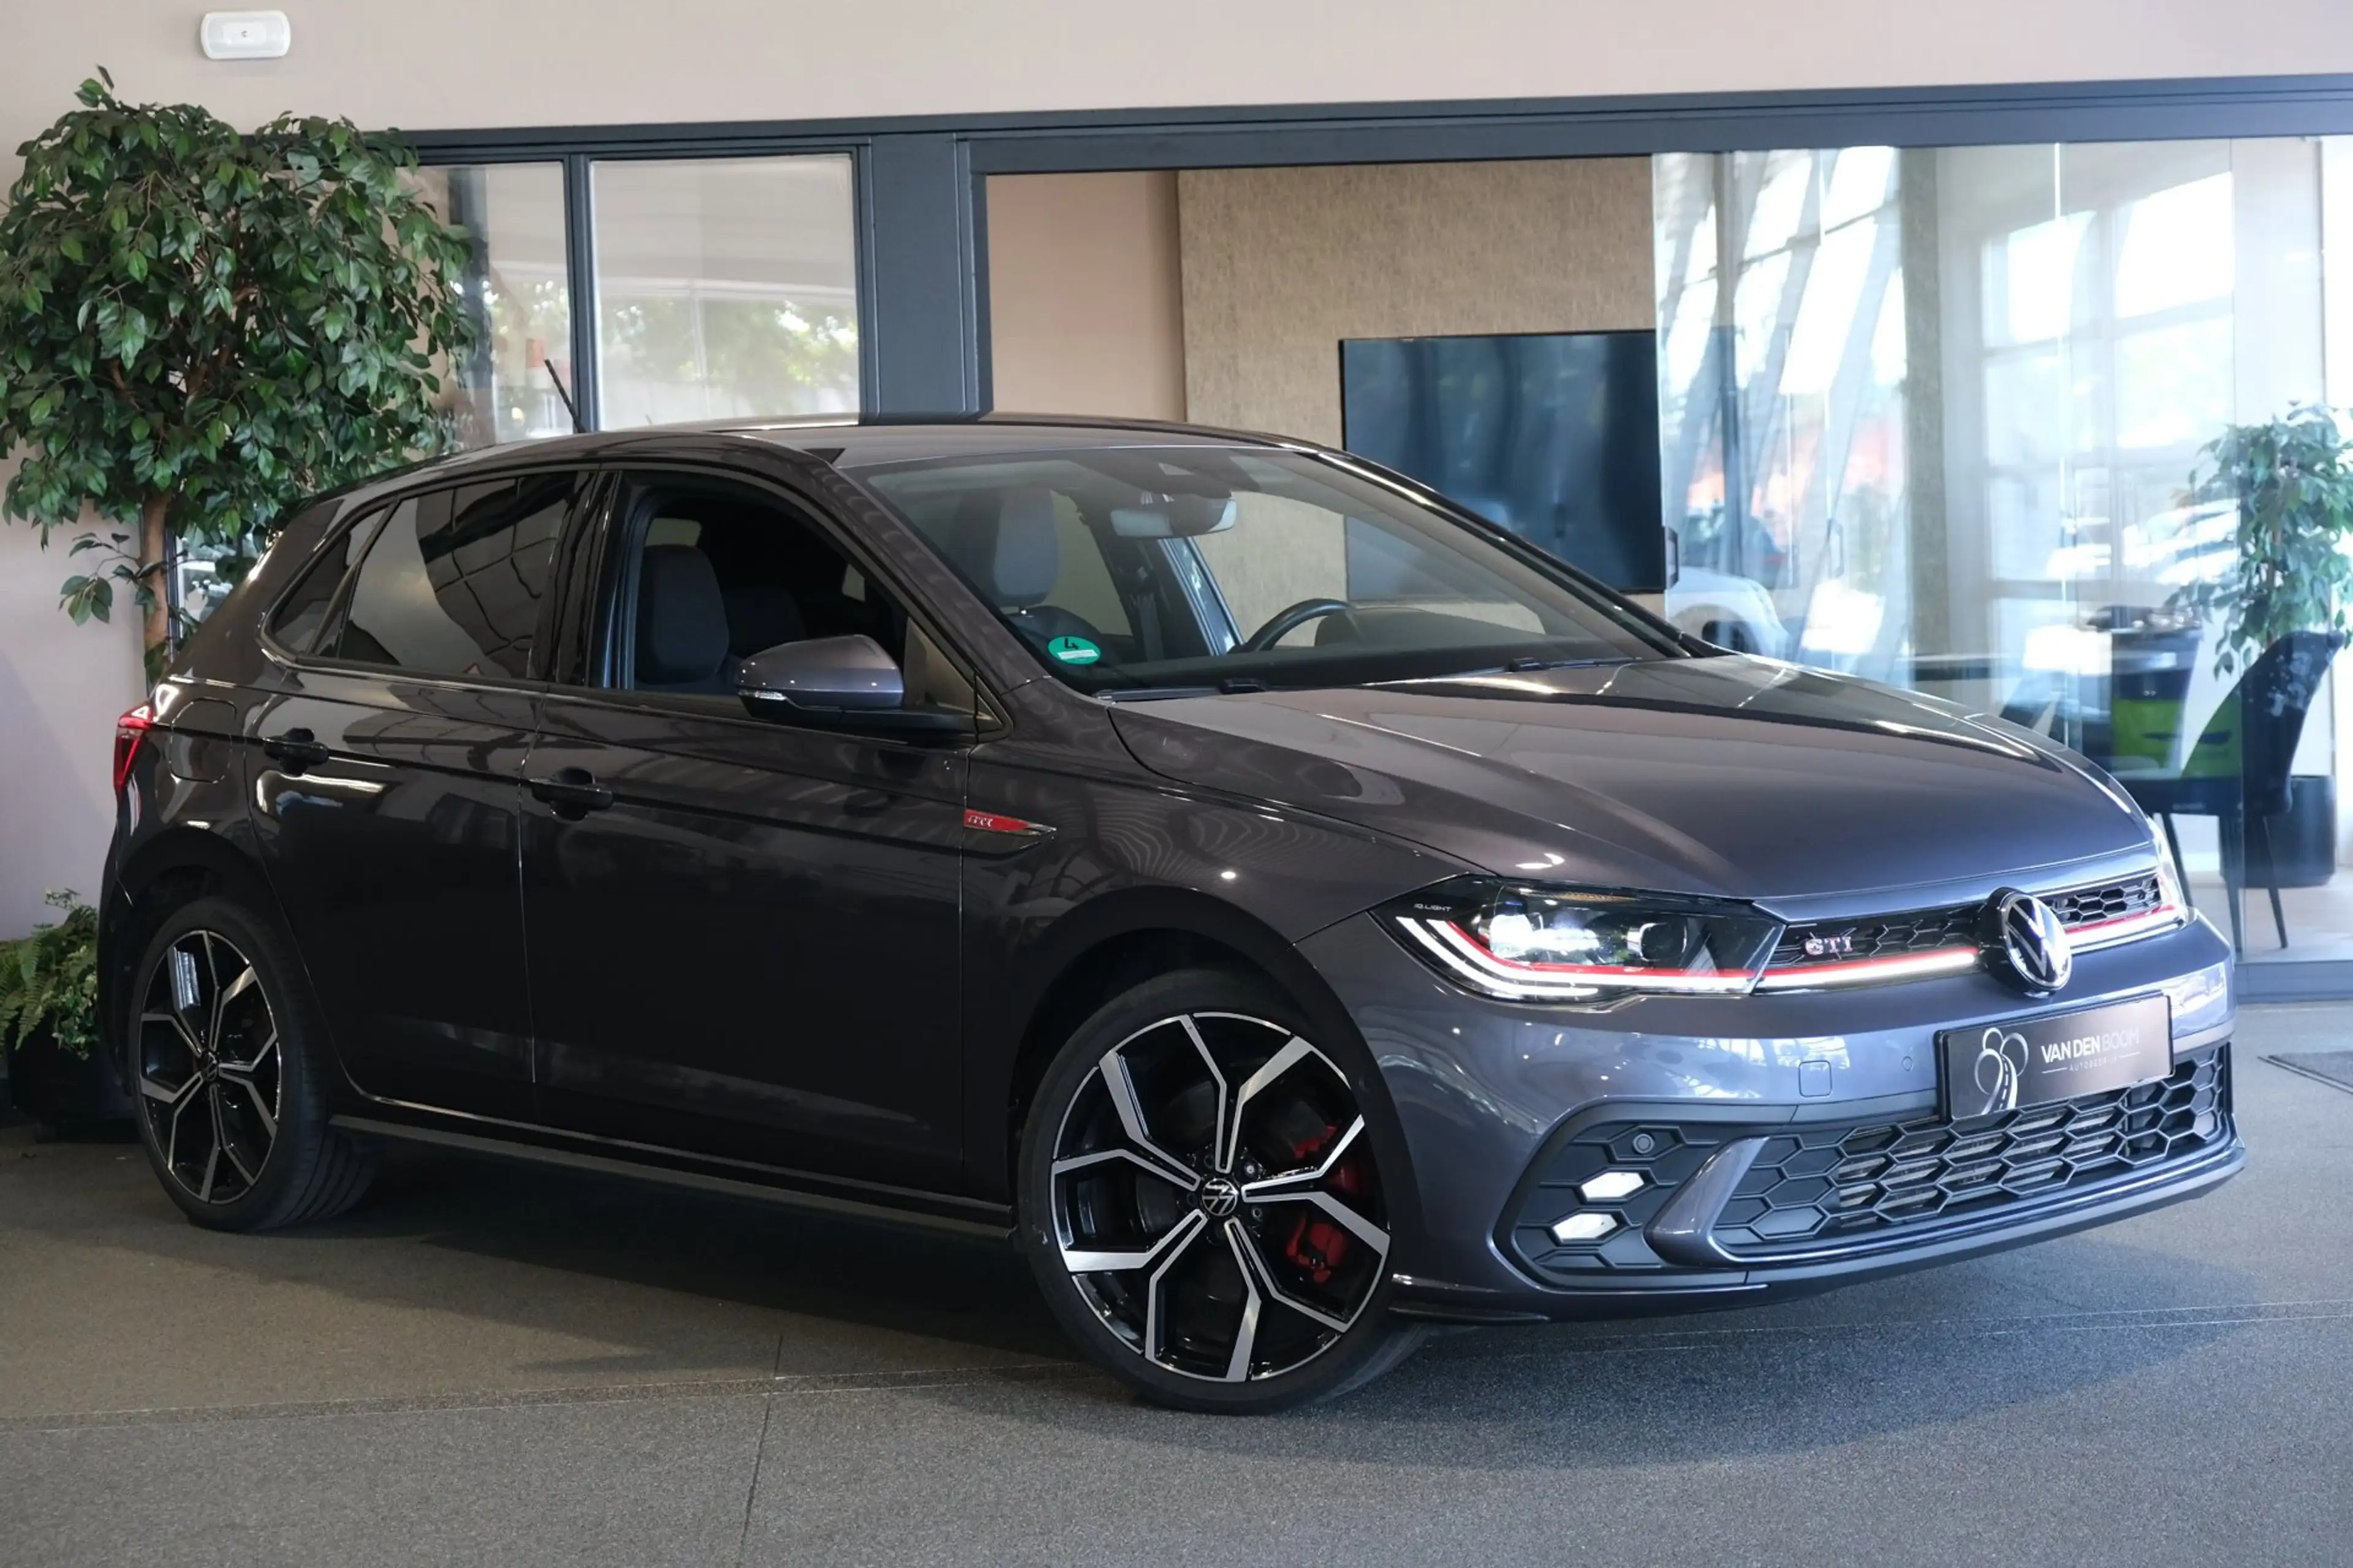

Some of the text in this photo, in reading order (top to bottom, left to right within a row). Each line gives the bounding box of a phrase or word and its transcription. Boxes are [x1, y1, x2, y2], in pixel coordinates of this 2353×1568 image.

[1064, 637, 1079, 650] 4
[1805, 936, 1853, 956] GTI
[2102, 1027, 2140, 1052] BOOM
